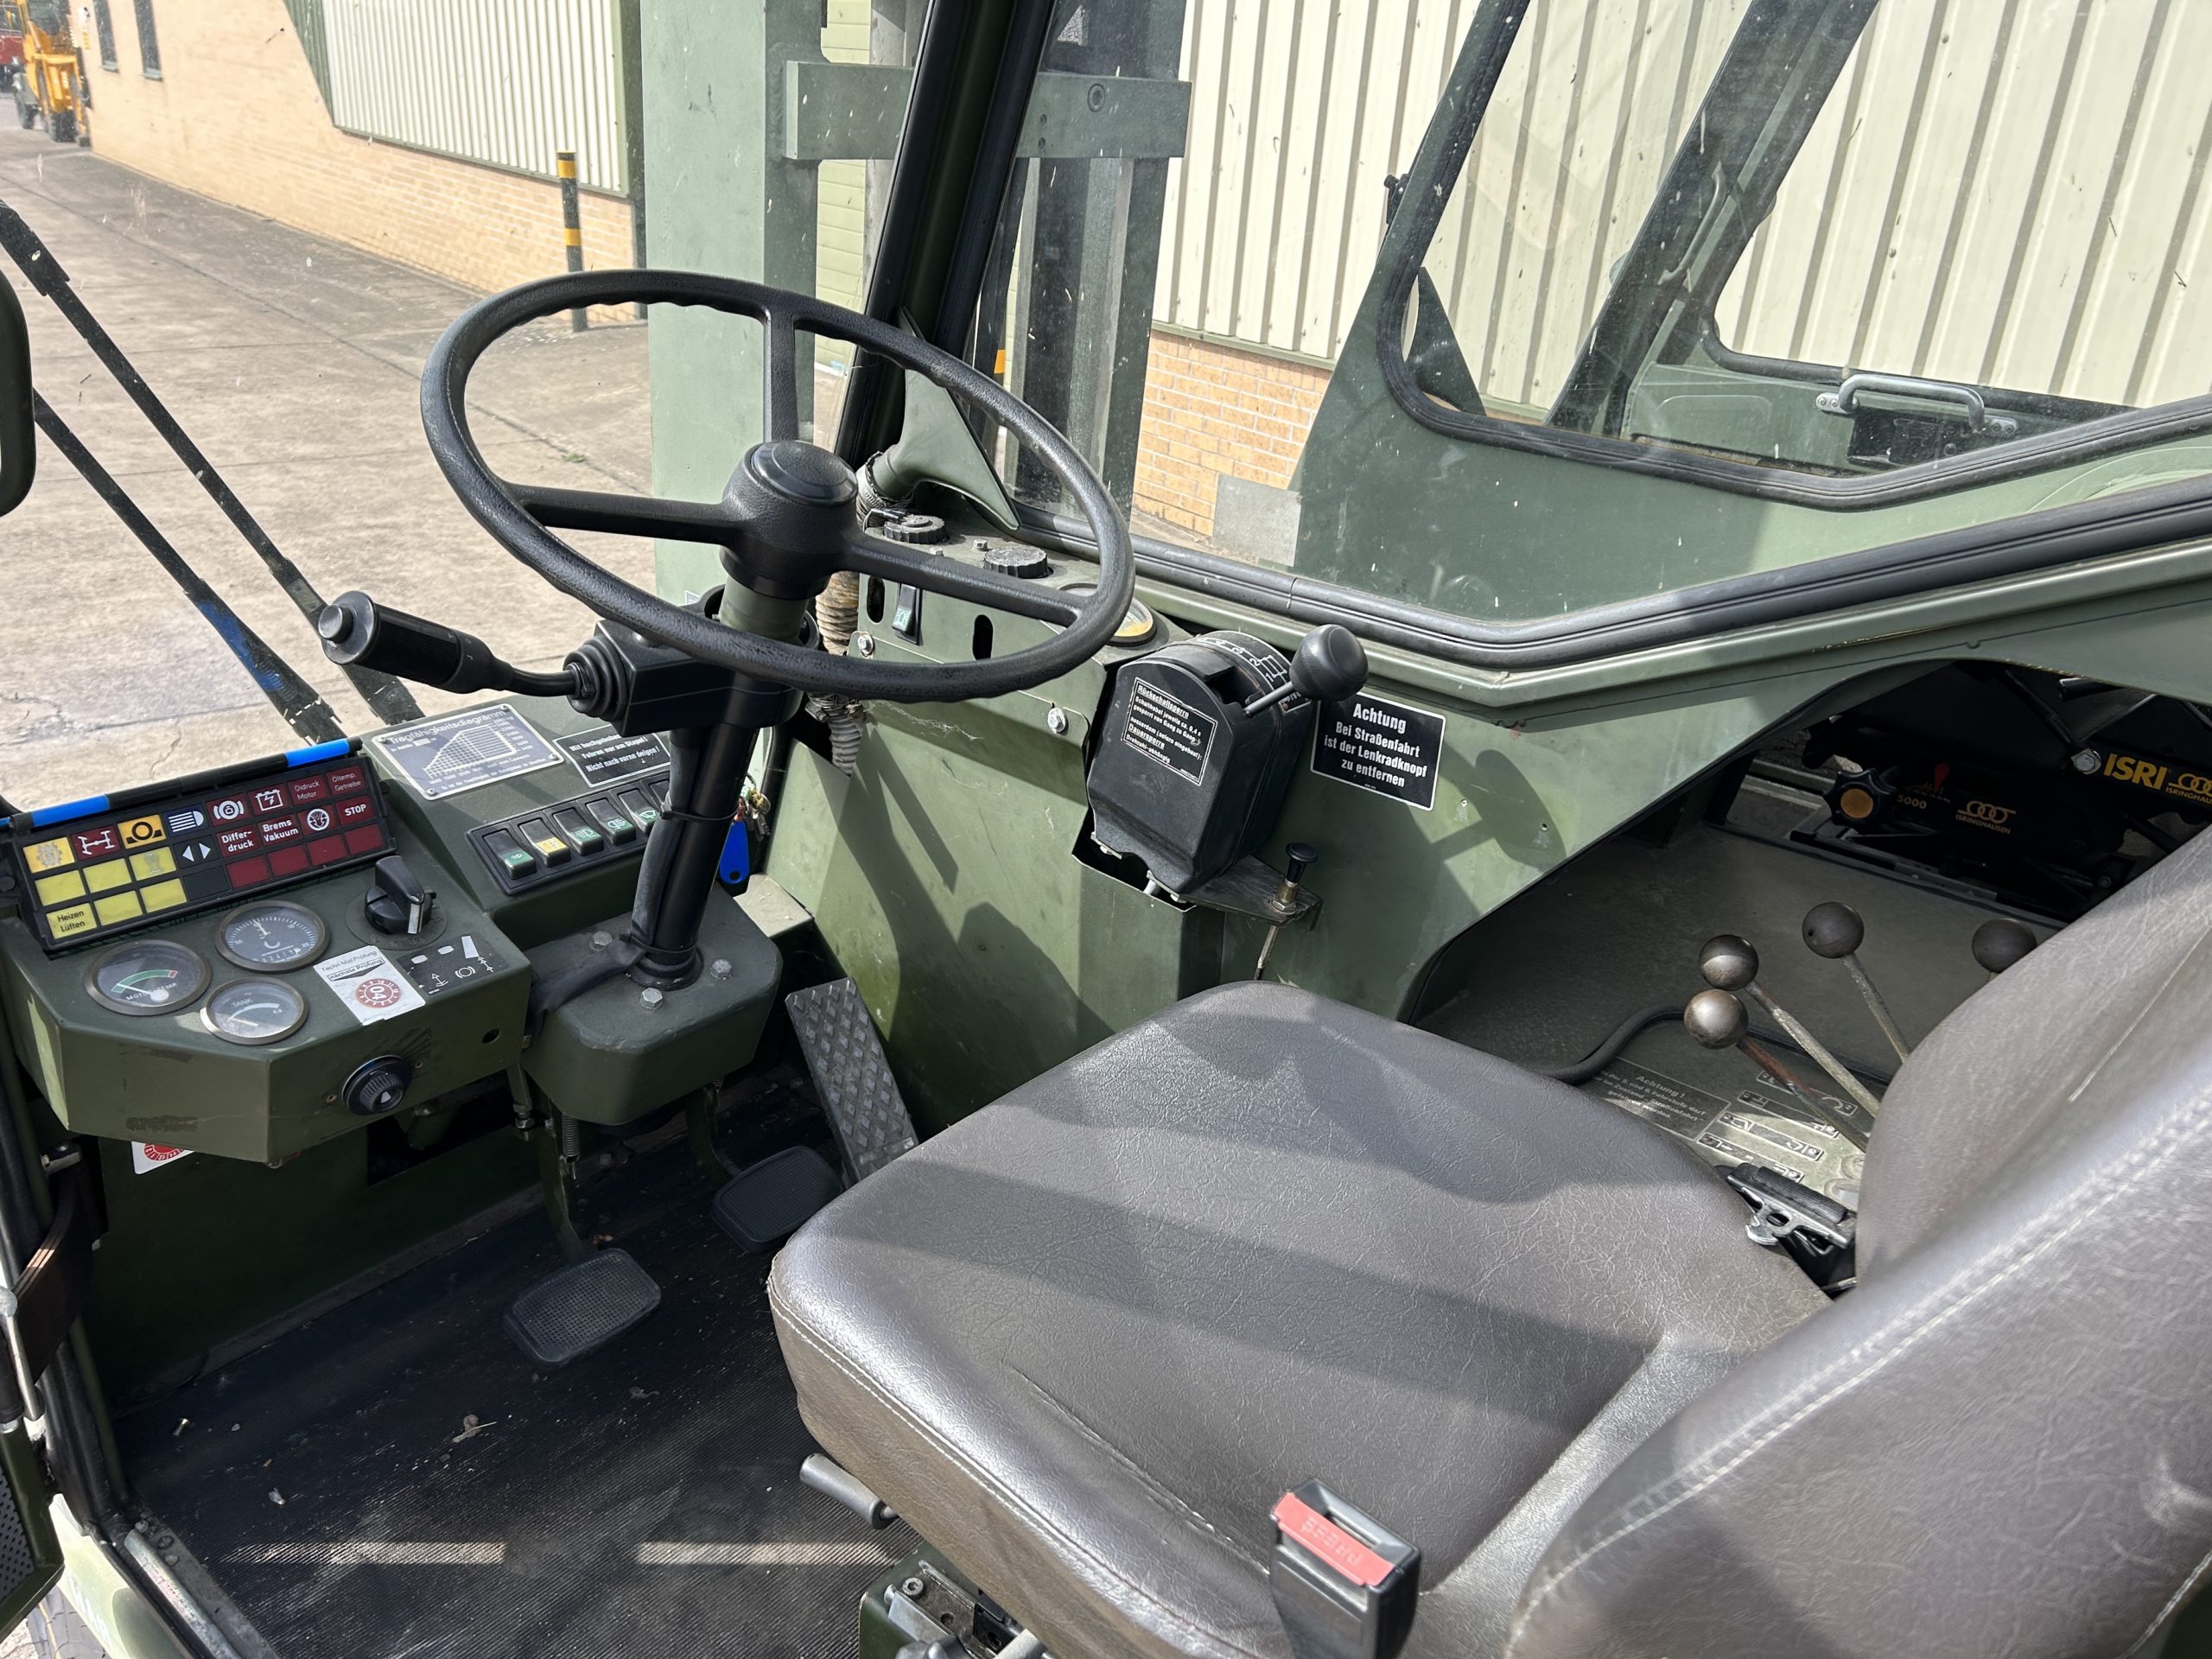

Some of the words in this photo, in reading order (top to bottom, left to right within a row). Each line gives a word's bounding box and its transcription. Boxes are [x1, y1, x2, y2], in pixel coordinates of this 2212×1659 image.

[1249, 658, 1261, 667] 2
[1266, 672, 1274, 682] 1
[1163, 719, 1176, 732] Gang
[1352, 703, 1407, 734] Achtung
[388, 710, 506, 745] Tragfähigkeitsdiagramm
[1128, 723, 1166, 749] Dauersperre
[1336, 721, 1352, 736] Bei
[1354, 727, 1420, 758] Straßenfahrt
[582, 749, 604, 760] Fahren
[1324, 734, 1337, 749] ist
[1339, 741, 1356, 754] der
[1358, 745, 1427, 778] Lenkradknopf
[586, 761, 604, 772] Nicht
[604, 757, 620, 767] nach
[619, 753, 637, 762] vorne
[1341, 759, 1353, 771] zu
[1356, 764, 1405, 787] entfernen
[2103, 753, 2168, 790] ISRI
[334, 779, 362, 791] Getriebe
[297, 791, 317, 800] Motor
[1896, 794, 1927, 809] 5000
[345, 804, 367, 817] STOP
[263, 819, 292, 832] Brems
[1955, 813, 2012, 835] ISRINGHAUSEN
[221, 830, 252, 844] Differ-
[264, 828, 299, 842] Vakuum
[227, 839, 254, 852] druck
[57, 910, 85, 922] Heizen
[60, 920, 86, 932] Lüften
[353, 951, 378, 963] Prüfung
[330, 969, 356, 980] nächste
[356, 959, 383, 971] Prüfung
[371, 986, 387, 1000] 04
[1614, 1084, 1644, 1099] Zustand
[1636, 1076, 1679, 1096] Achtung
[1608, 1090, 1641, 1107] gefahren
[1651, 1090, 1688, 1109] Fahrstufe
[1689, 1106, 1707, 1116] darf
[1300, 1516, 1363, 1567] PRESS
